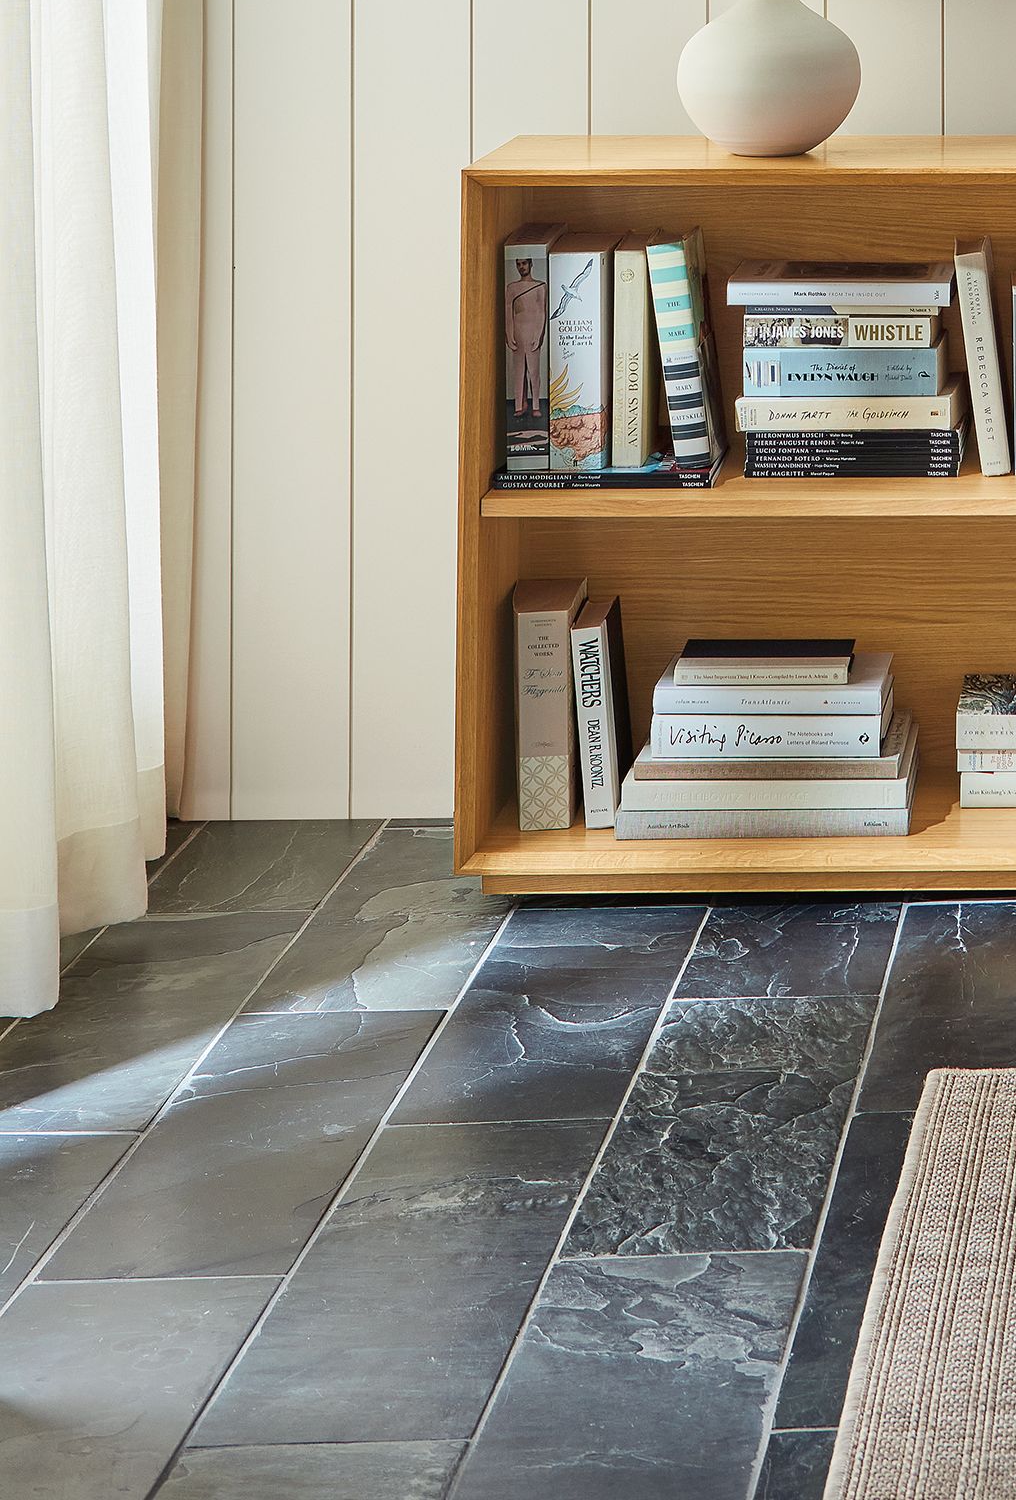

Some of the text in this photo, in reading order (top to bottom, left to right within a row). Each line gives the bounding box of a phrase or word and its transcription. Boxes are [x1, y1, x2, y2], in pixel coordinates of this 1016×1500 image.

[966, 272, 977, 325] GLENDINNING
[973, 280, 982, 316] VICTORIA
[668, 329, 687, 337] MARE
[772, 326, 806, 338] JAMES
[810, 326, 844, 338] JONES
[854, 324, 924, 341] WHISTLE
[849, 364, 858, 373] of
[787, 373, 879, 382] EVELYN WAUGH
[675, 383, 693, 392] MARY
[975, 336, 995, 442] REBECCA WEST
[628, 352, 639, 448] ANNA'S BOOK
[671, 411, 705, 422] GAITSKILL
[768, 409, 797, 421] DONNA
[798, 411, 832, 420] TARTT
[862, 407, 910, 425] GOLDFINCH
[578, 638, 602, 708] WATCHERS
[521, 685, 567, 699] Fitzgerald
[587, 718, 602, 756] DEAN R.
[670, 724, 726, 752] Visiting
[735, 724, 783, 747] Picasso
